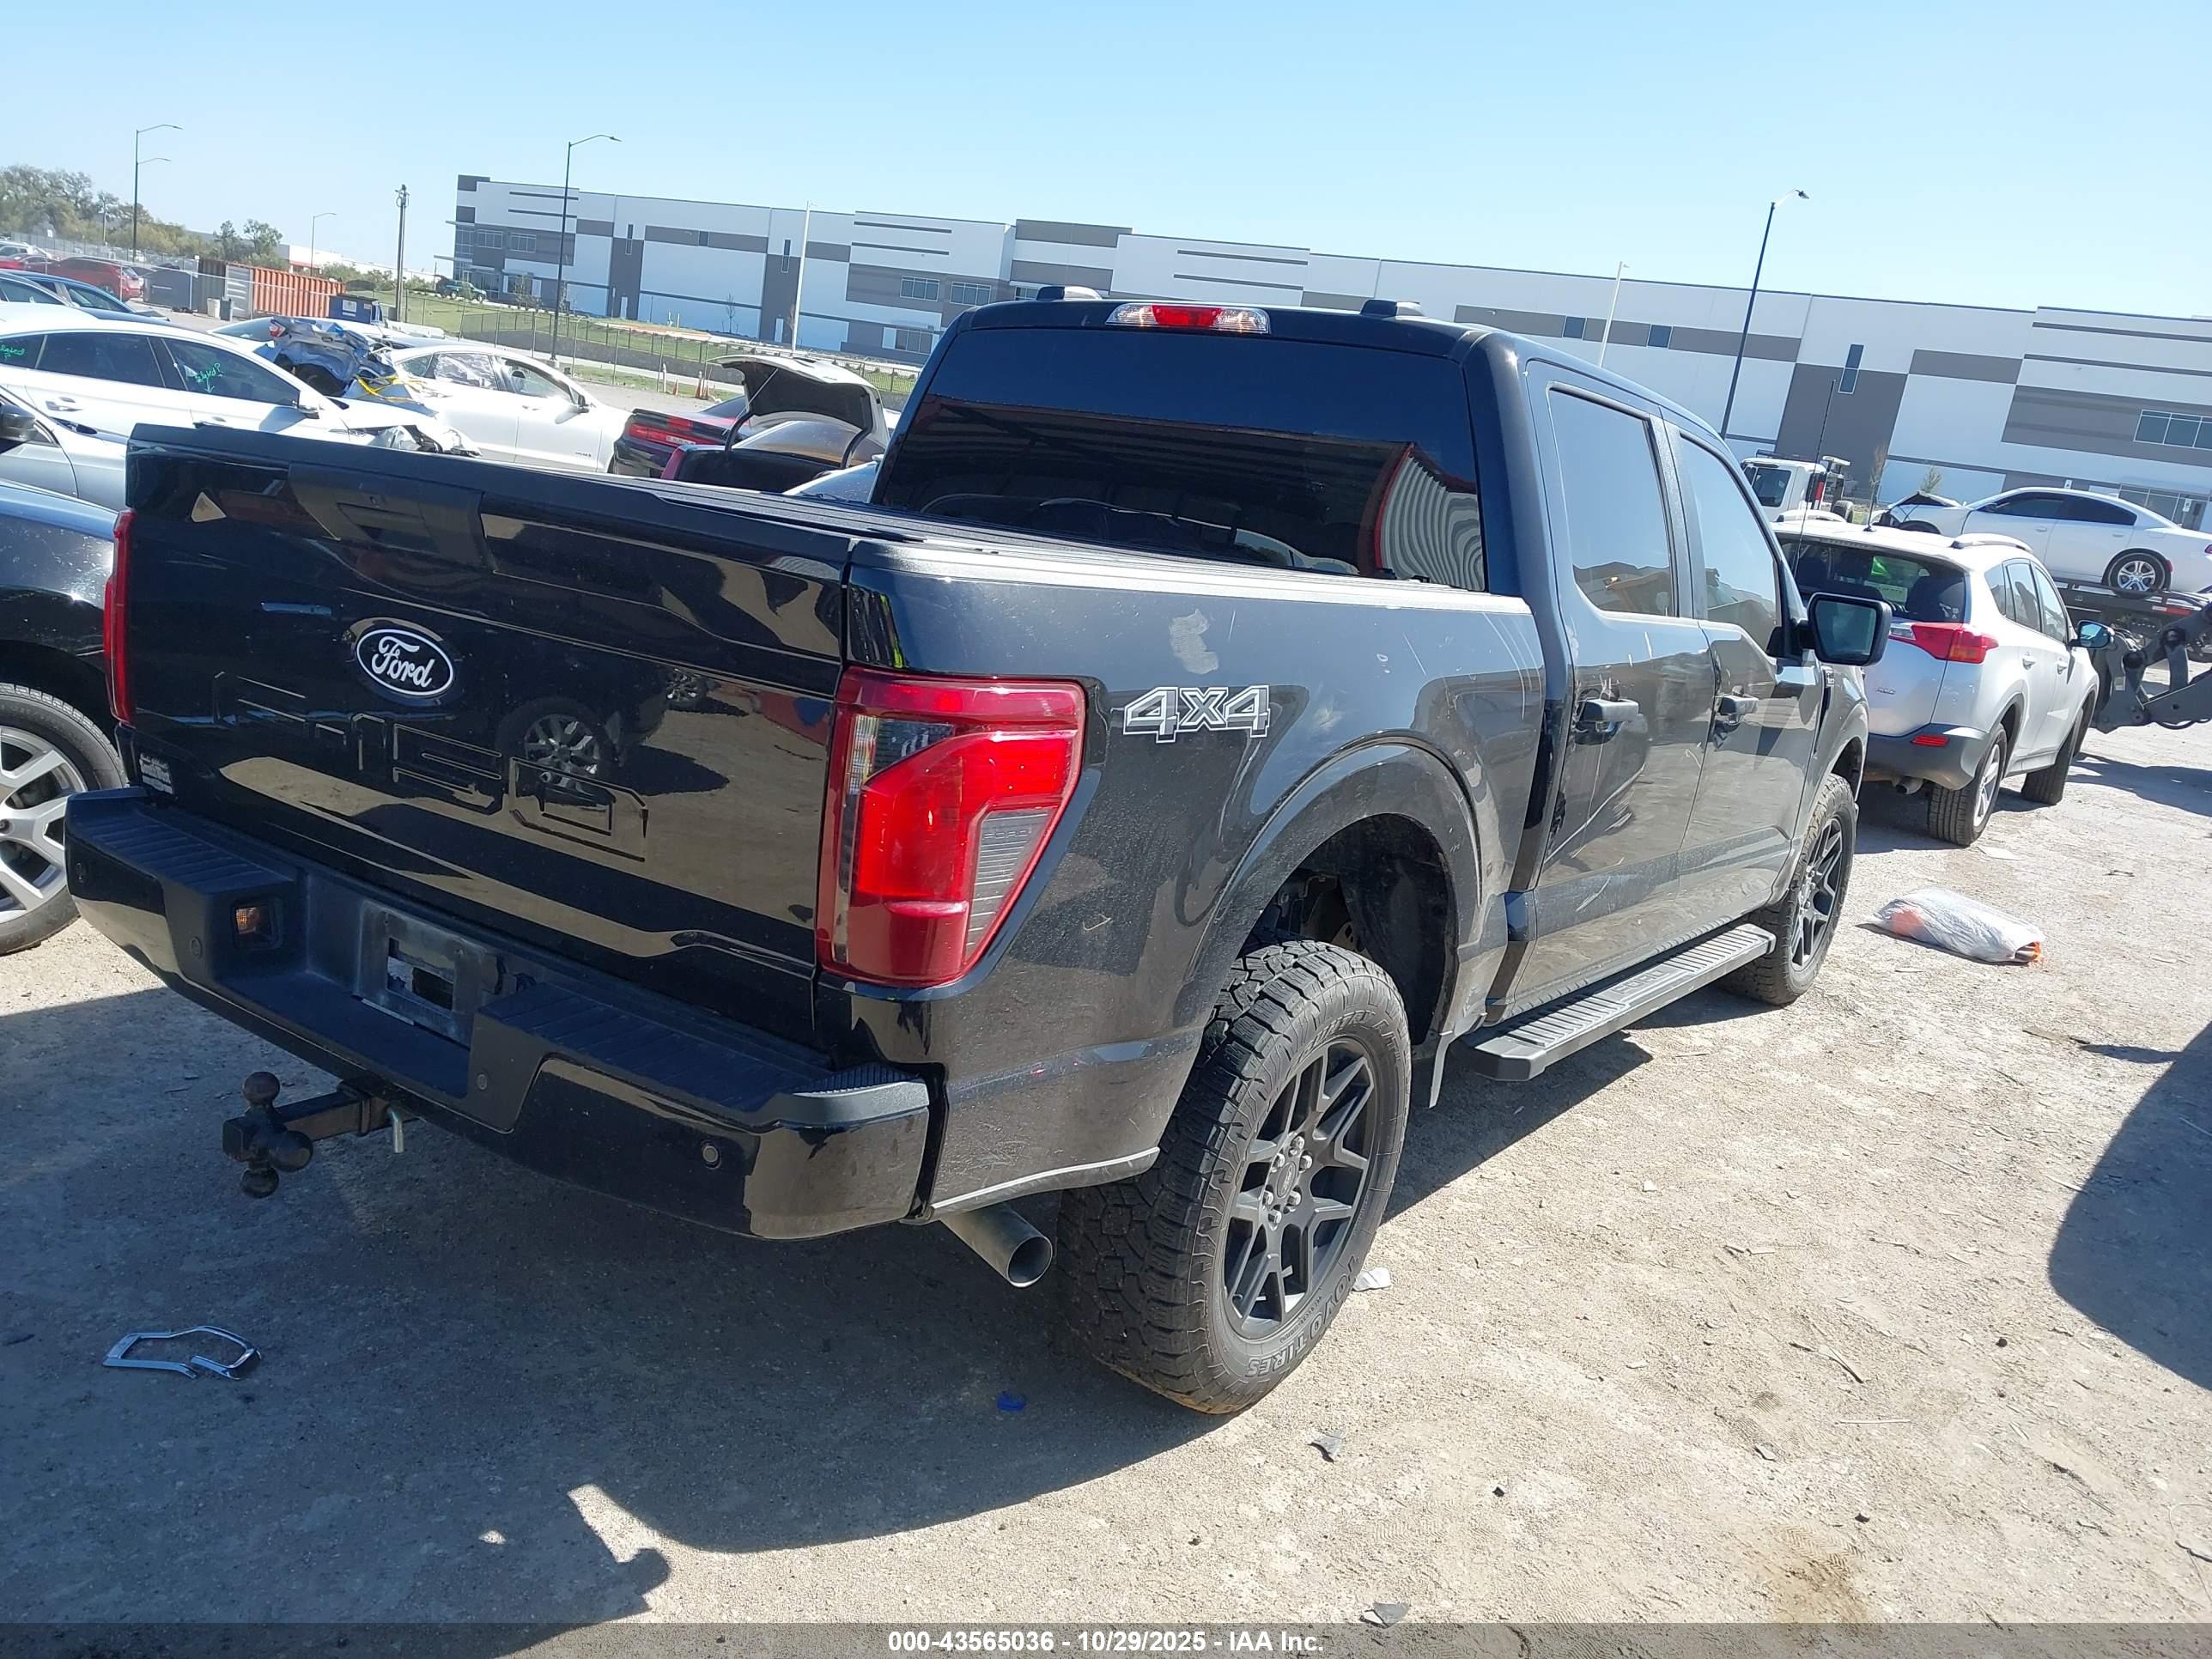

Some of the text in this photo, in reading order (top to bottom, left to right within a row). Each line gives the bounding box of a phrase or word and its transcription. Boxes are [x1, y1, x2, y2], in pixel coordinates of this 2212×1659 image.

[371, 635, 435, 688] Ford
[1310, 1255, 1360, 1340] TOYO
[1245, 1330, 1309, 1378] TIRES
